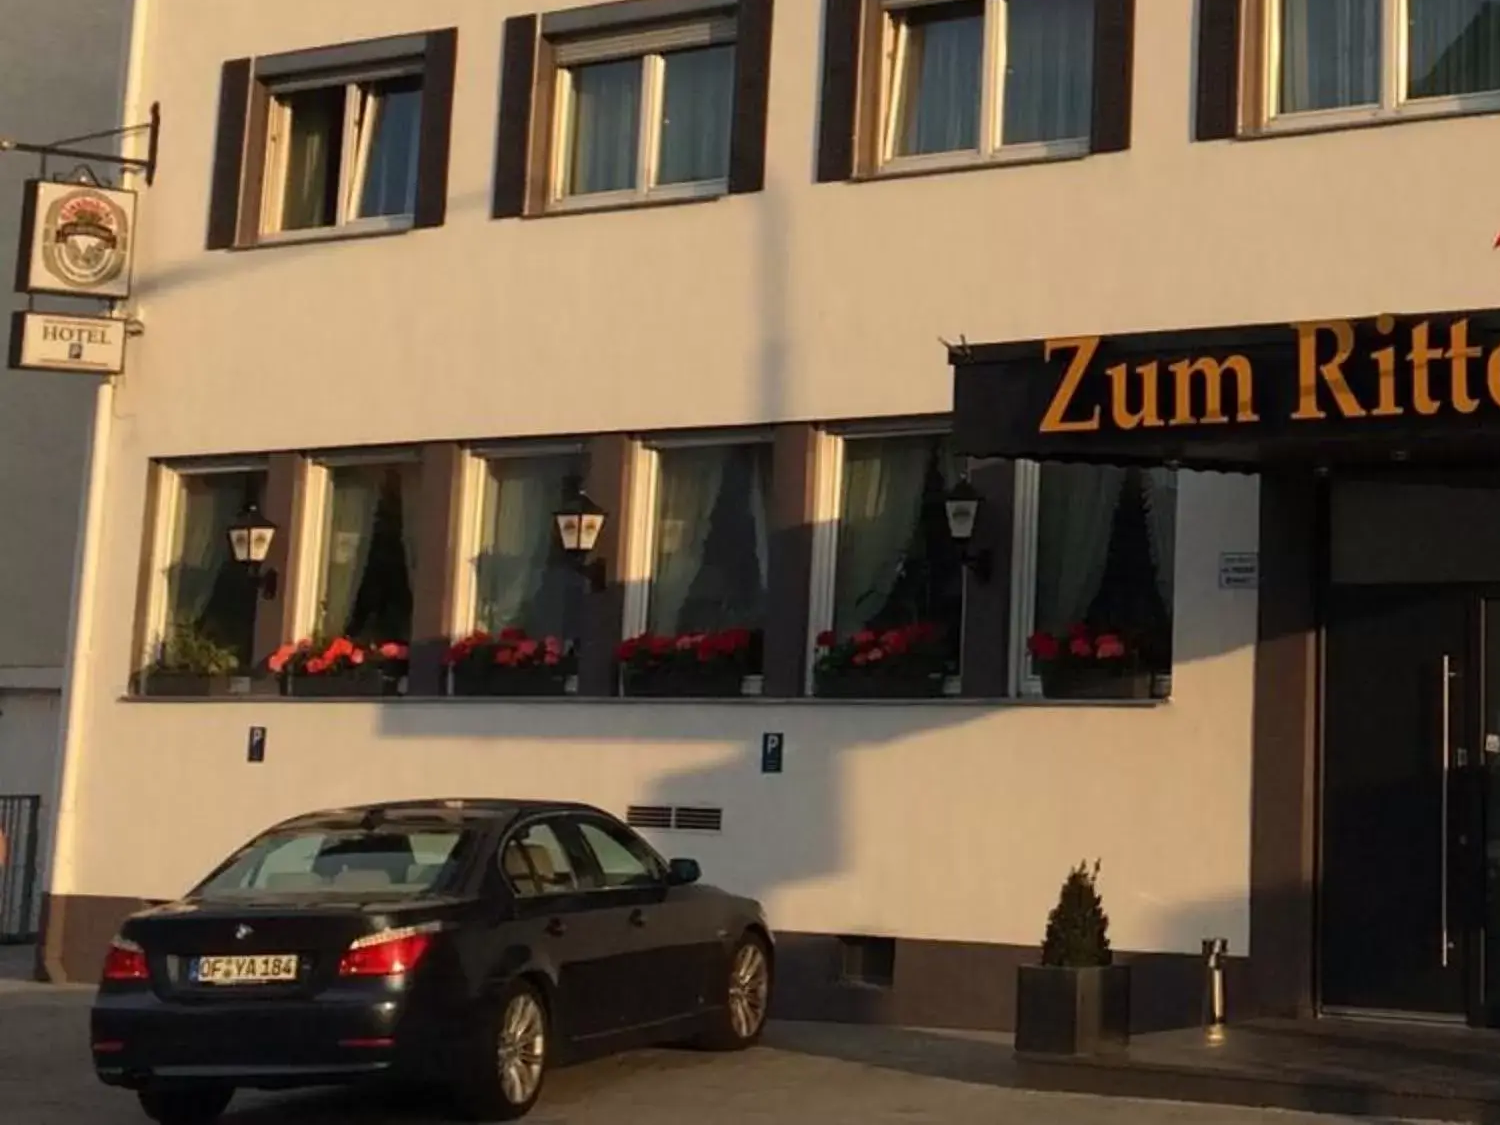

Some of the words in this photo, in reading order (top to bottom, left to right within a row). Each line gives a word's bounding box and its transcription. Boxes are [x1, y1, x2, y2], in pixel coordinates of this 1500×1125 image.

[42, 325, 112, 345] HOTEL
[1039, 335, 1260, 432] Zum
[767, 735, 779, 754] P
